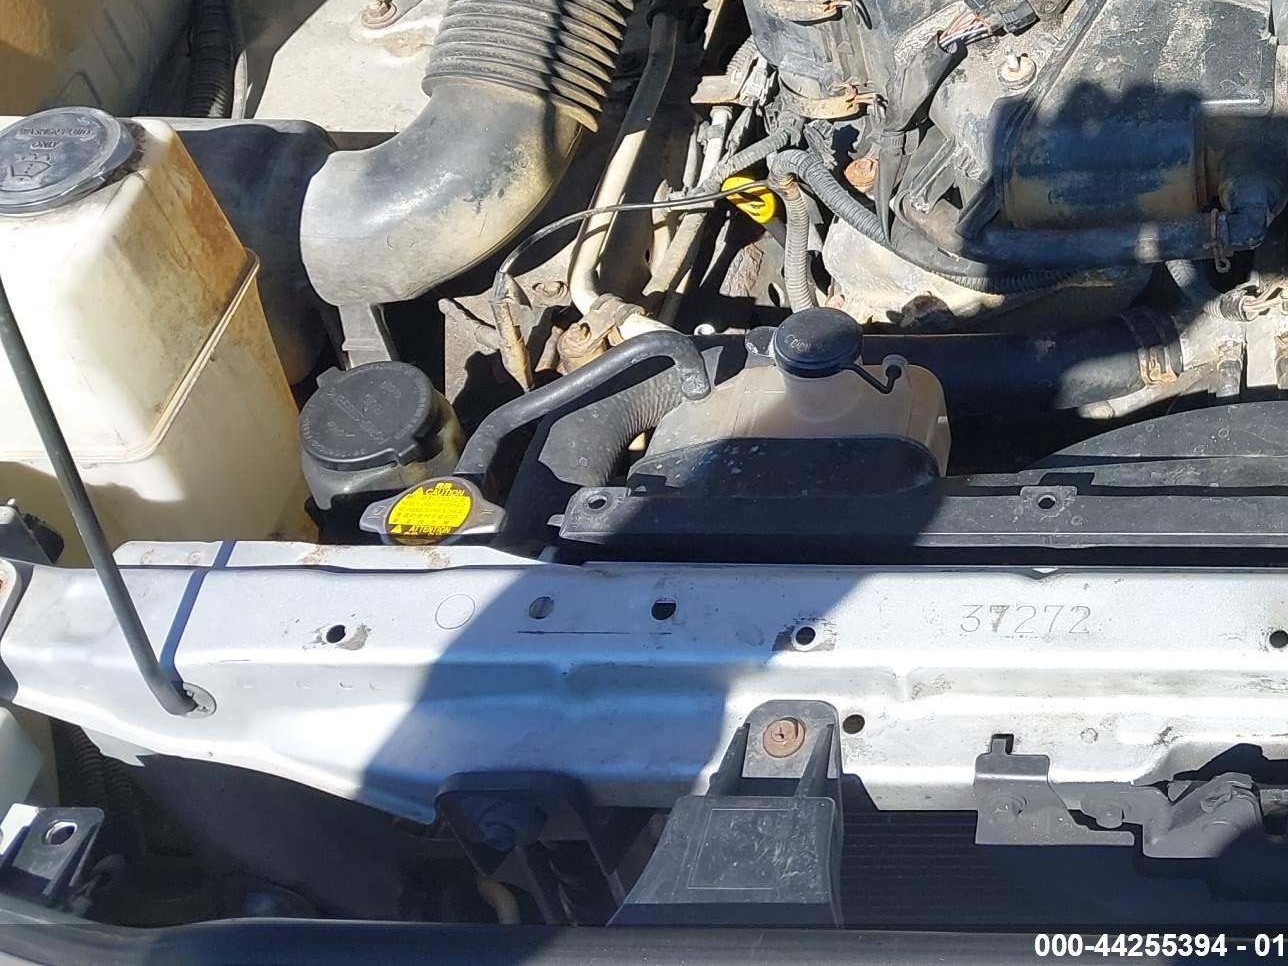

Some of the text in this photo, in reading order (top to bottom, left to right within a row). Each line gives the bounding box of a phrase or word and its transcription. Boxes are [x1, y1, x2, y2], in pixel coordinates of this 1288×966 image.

[425, 488, 465, 497] CAUTION
[408, 524, 452, 534] ATTENTION
[959, 603, 1091, 634] 37272
